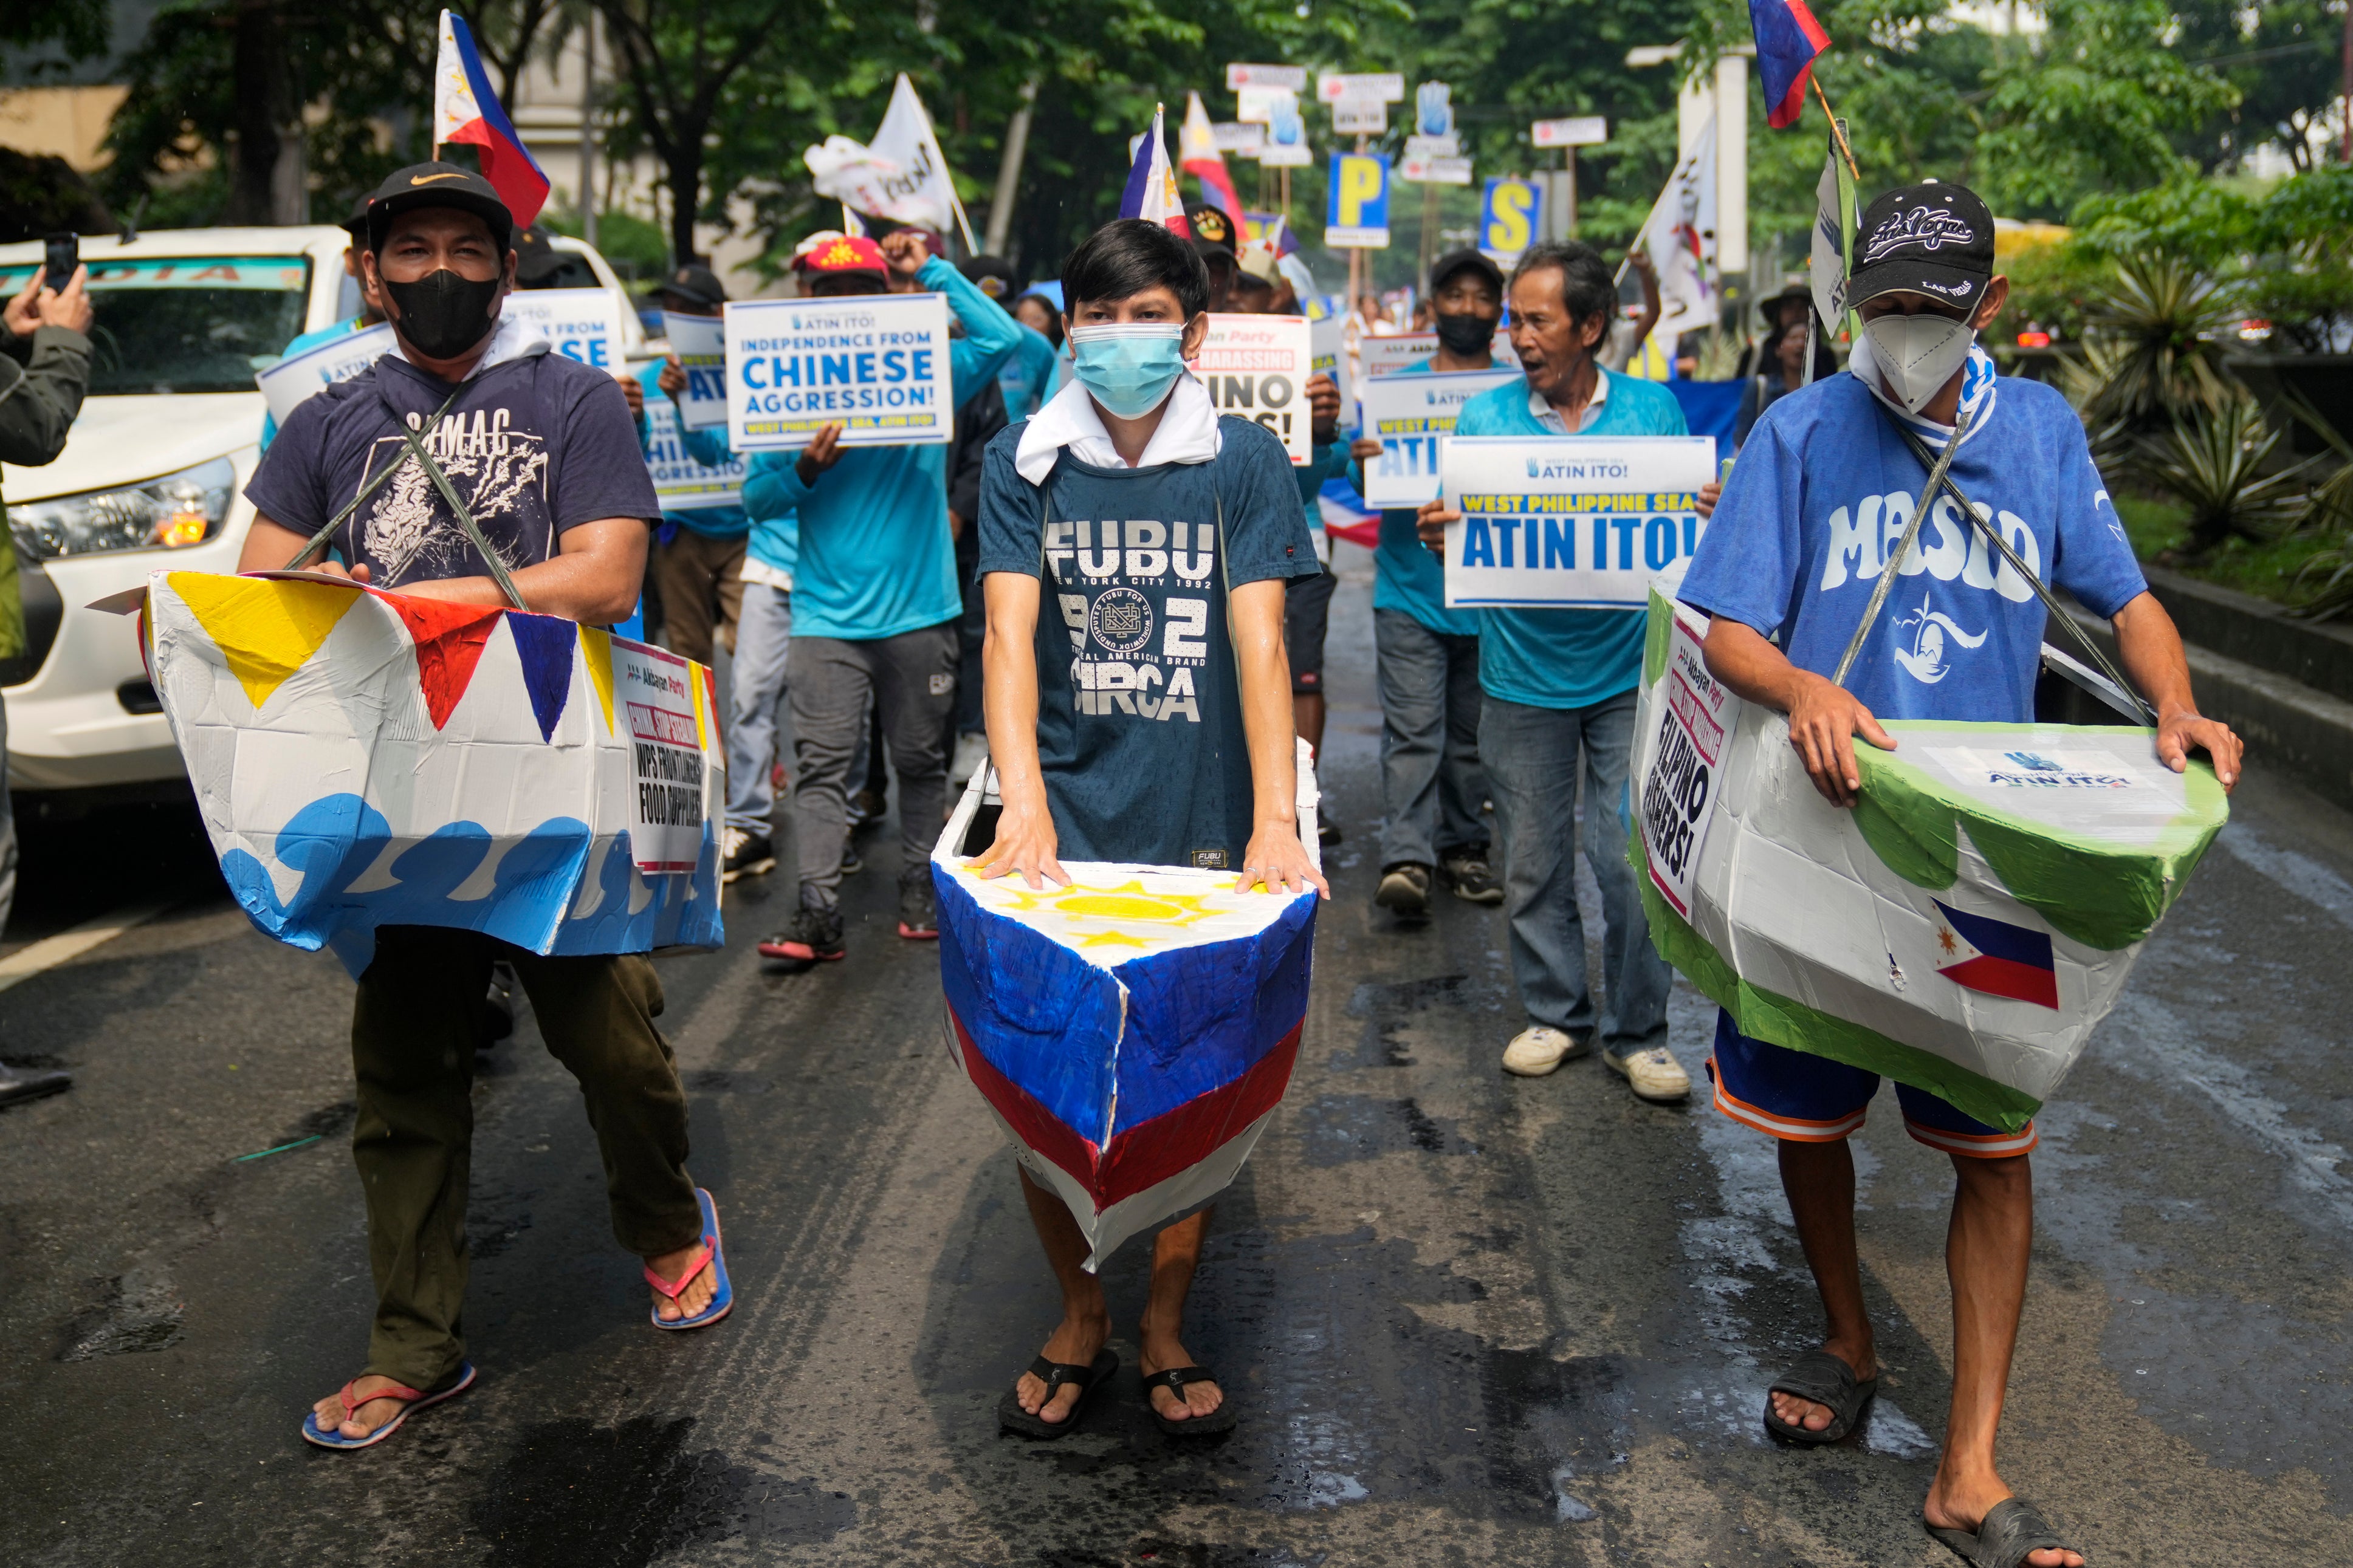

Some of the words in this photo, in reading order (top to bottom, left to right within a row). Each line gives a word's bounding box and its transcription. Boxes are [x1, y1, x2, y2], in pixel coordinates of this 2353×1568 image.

[1338, 157, 1382, 227] P
[1488, 183, 1533, 251] S
[1907, 207, 1969, 250] Vegas
[1922, 281, 1948, 294] LAS
[1948, 280, 1973, 297] VEGAS
[741, 334, 873, 352] INDEPENDENCE
[881, 331, 931, 346] FROM
[806, 317, 839, 330] ATIN
[845, 317, 875, 329] ITO!
[743, 350, 933, 389] CHINESE
[746, 387, 934, 414] AGGRESSION!
[1200, 375, 1294, 409] INO
[1379, 419, 1426, 434] WEST
[1542, 465, 1585, 478] ATIN
[1591, 465, 1628, 478] ITO!
[1463, 495, 1523, 513] WEST
[1528, 495, 1648, 513] PHILIPPINE
[1045, 520, 1214, 580] FUBU
[1462, 517, 1576, 570] ATIN
[1592, 516, 1697, 571] ITO!
[1132, 577, 1165, 586] CITY
[1176, 579, 1212, 589] 1992
[1101, 591, 1122, 603] FUBU
[1127, 591, 1142, 603] FOR
[1142, 604, 1150, 616] US
[1108, 652, 1159, 664] AMERICAN
[1167, 657, 1206, 666] BRAND
[643, 667, 668, 693] Akbayan
[668, 676, 685, 699] Party
[1070, 657, 1201, 722] CIRCA
[1687, 656, 1710, 694] Akbayan
[1708, 680, 1725, 713] Party
[628, 704, 658, 739] CHINA,
[668, 713, 699, 747] STEALIN
[1681, 689, 1696, 727] STOP
[636, 742, 658, 780] WPS
[656, 746, 701, 786] FRONTLINERS
[1658, 707, 1709, 824] FILIPINO
[639, 782, 666, 825] FOOD
[667, 785, 702, 828] SUPPLIES!
